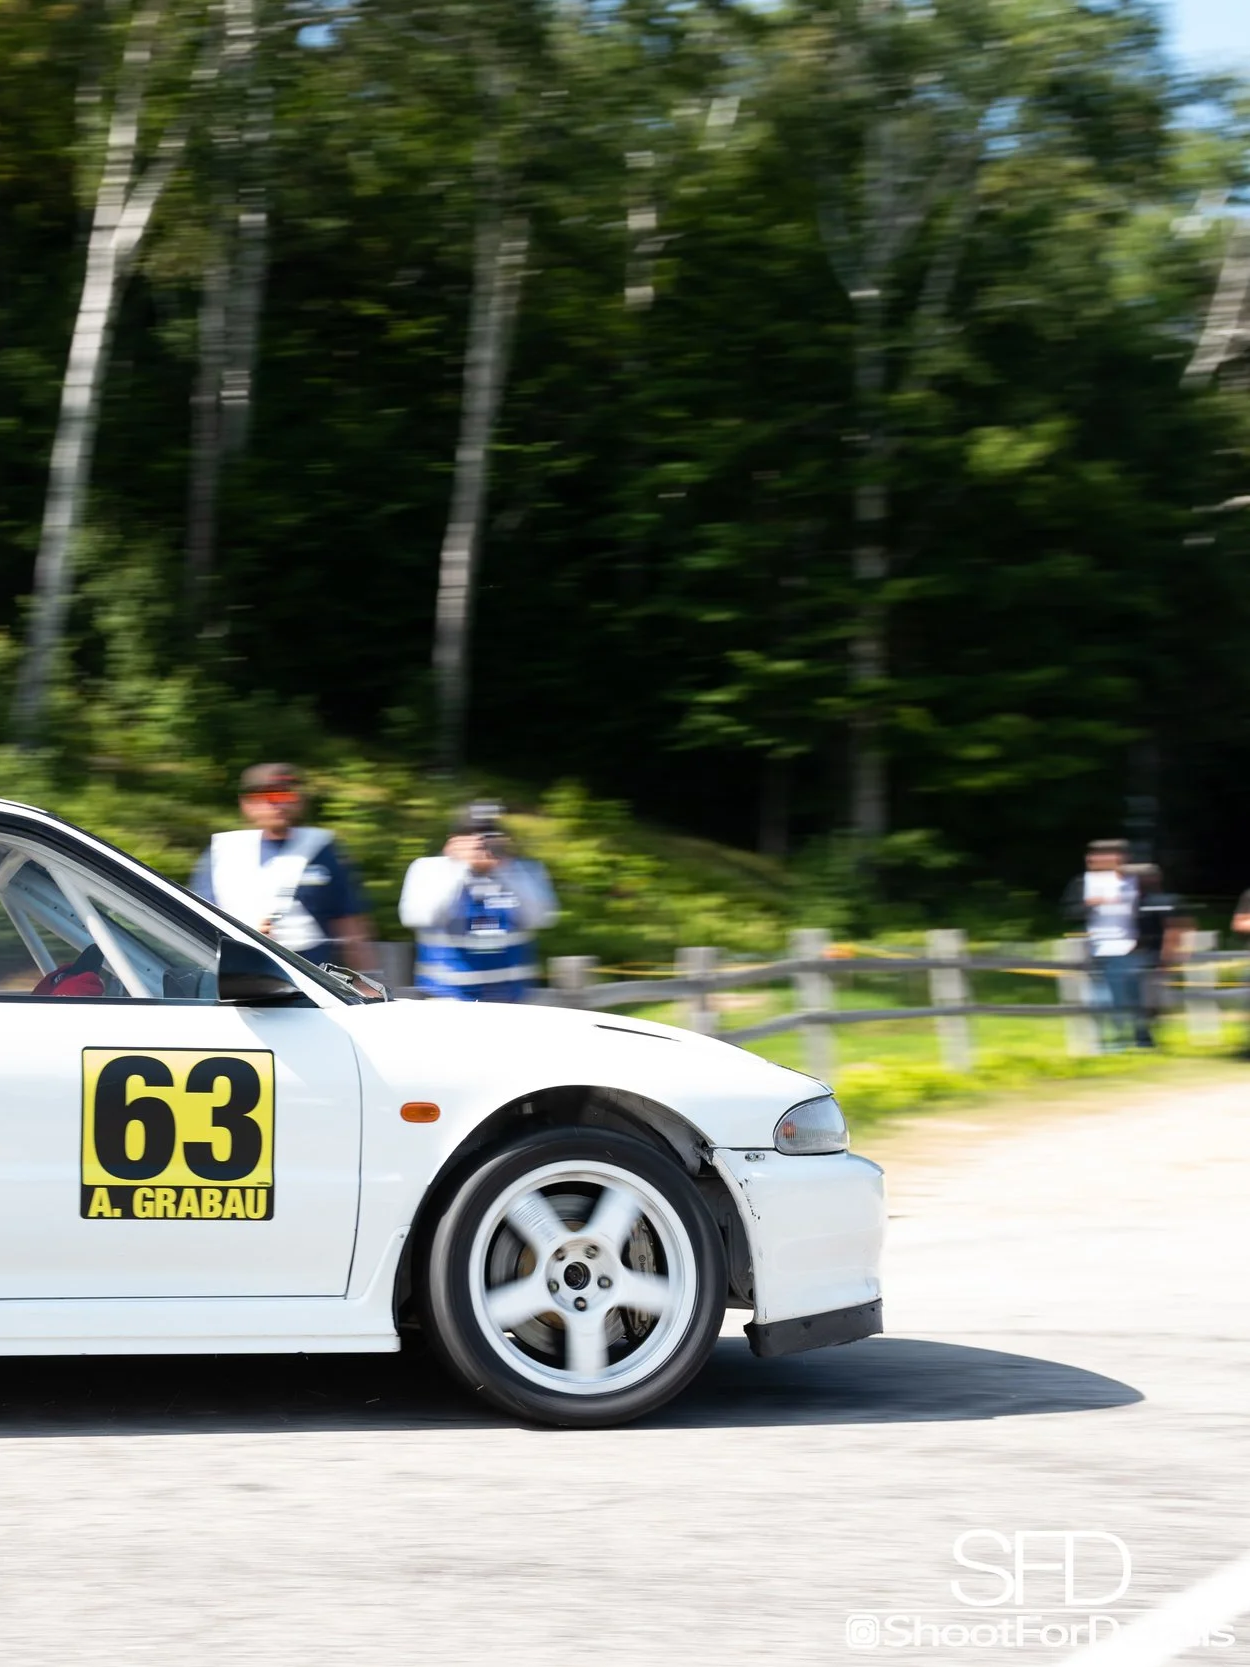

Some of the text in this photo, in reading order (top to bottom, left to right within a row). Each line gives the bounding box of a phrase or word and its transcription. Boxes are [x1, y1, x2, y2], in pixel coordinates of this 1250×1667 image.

[94, 1055, 263, 1181] 63
[88, 1187, 268, 1219] A. GRABAU
